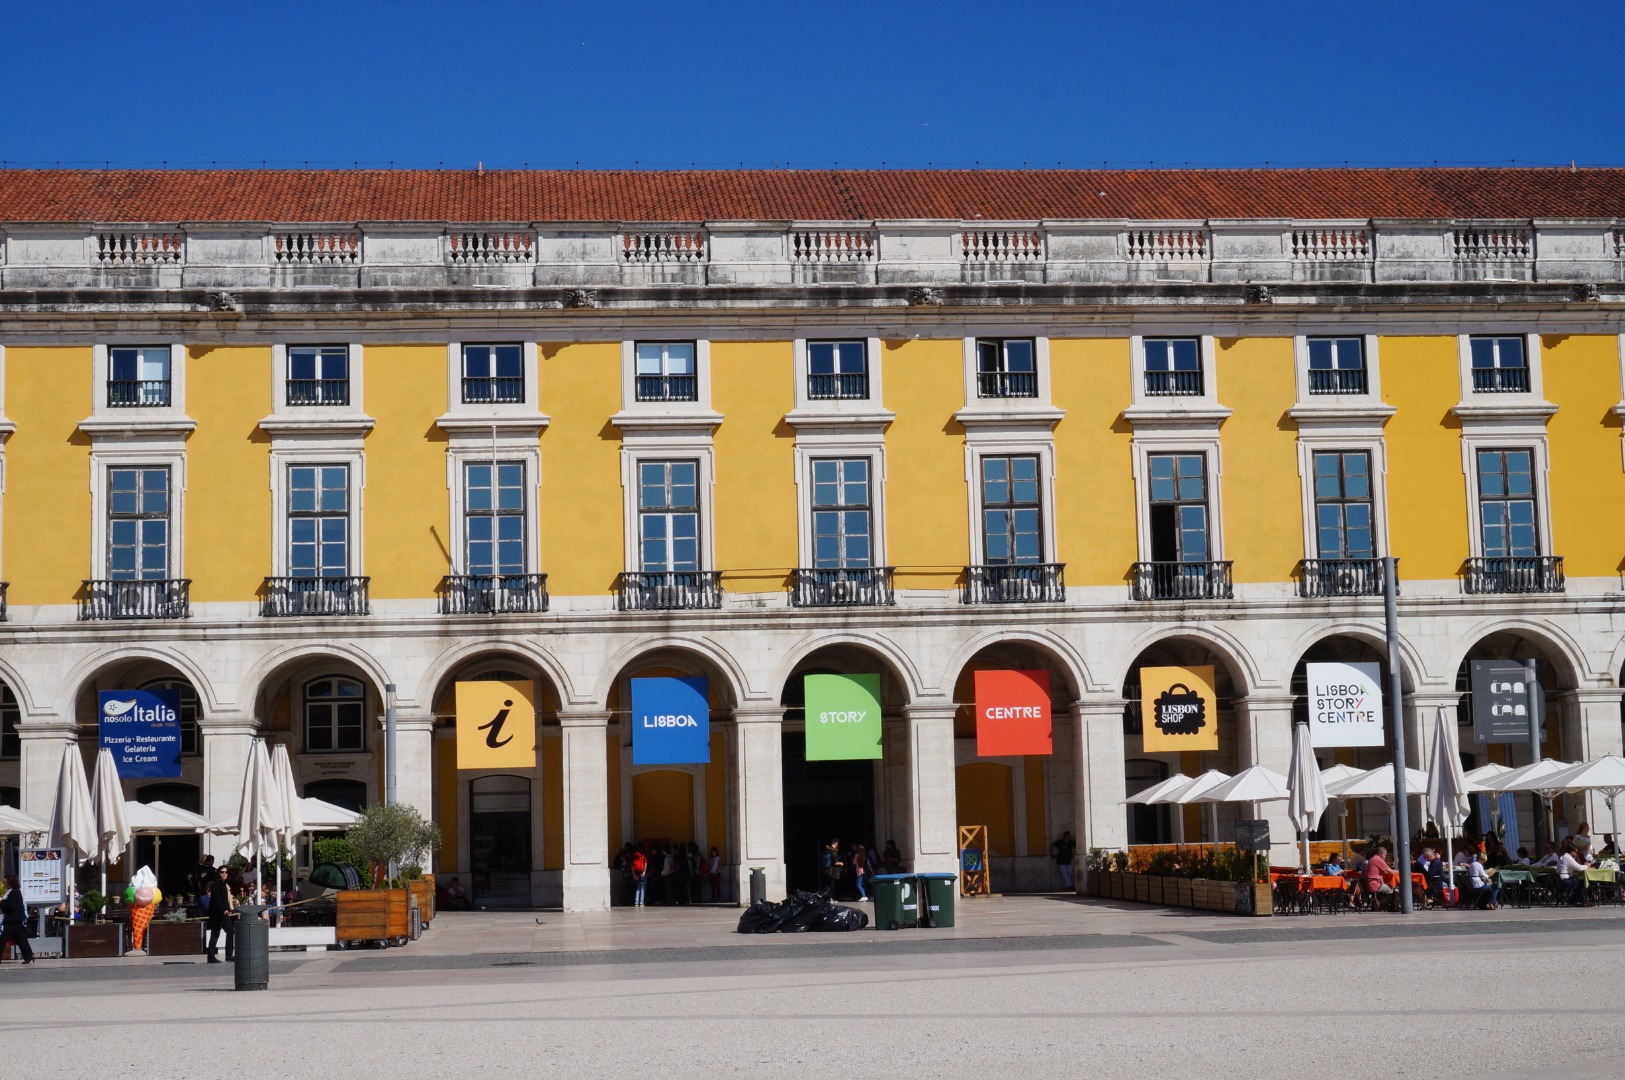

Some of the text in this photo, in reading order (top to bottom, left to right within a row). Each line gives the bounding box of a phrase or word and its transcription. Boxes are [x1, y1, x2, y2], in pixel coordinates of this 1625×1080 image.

[1315, 684, 1370, 697] LISBOA
[1161, 704, 1199, 714] LISBON
[1317, 697, 1364, 710] STORY
[133, 704, 176, 722] Italia
[819, 710, 867, 724] STORY
[985, 706, 1042, 720] CENTRE
[1161, 713, 1185, 724] SHOP
[1317, 710, 1375, 724] CENTRE
[643, 714, 698, 728] LISBOA
